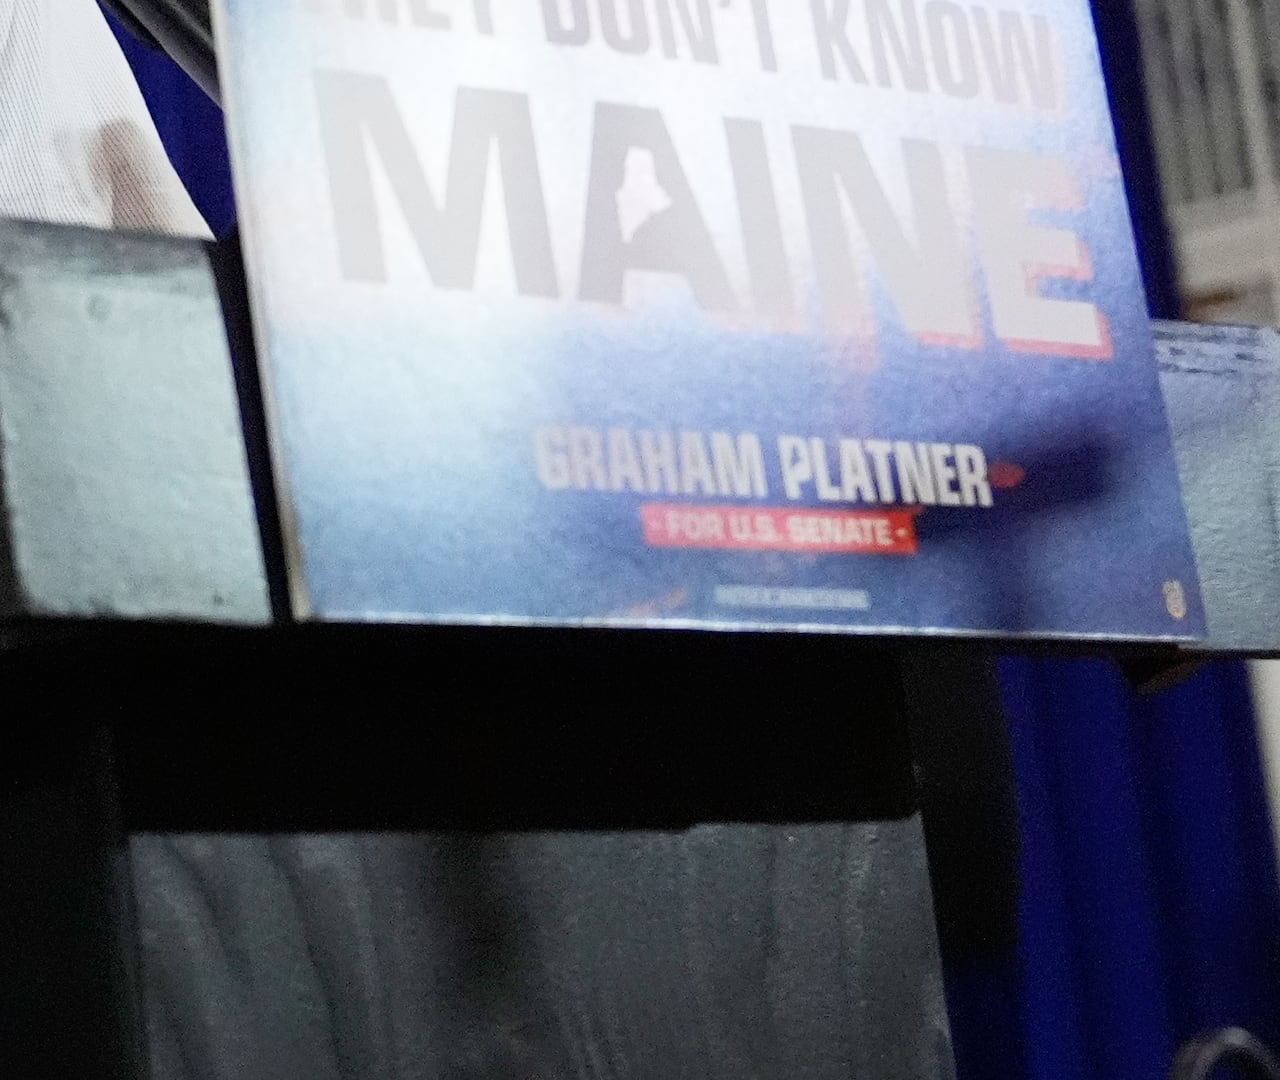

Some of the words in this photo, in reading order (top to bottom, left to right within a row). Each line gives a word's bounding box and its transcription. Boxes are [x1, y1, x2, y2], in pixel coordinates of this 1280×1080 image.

[312, 66, 1115, 360] MAINE
[538, 424, 770, 498] GRAHAM
[776, 433, 994, 508] PLATNER
[666, 509, 726, 540] FOR
[729, 512, 781, 543] U.S.
[786, 514, 894, 545] SENATE
